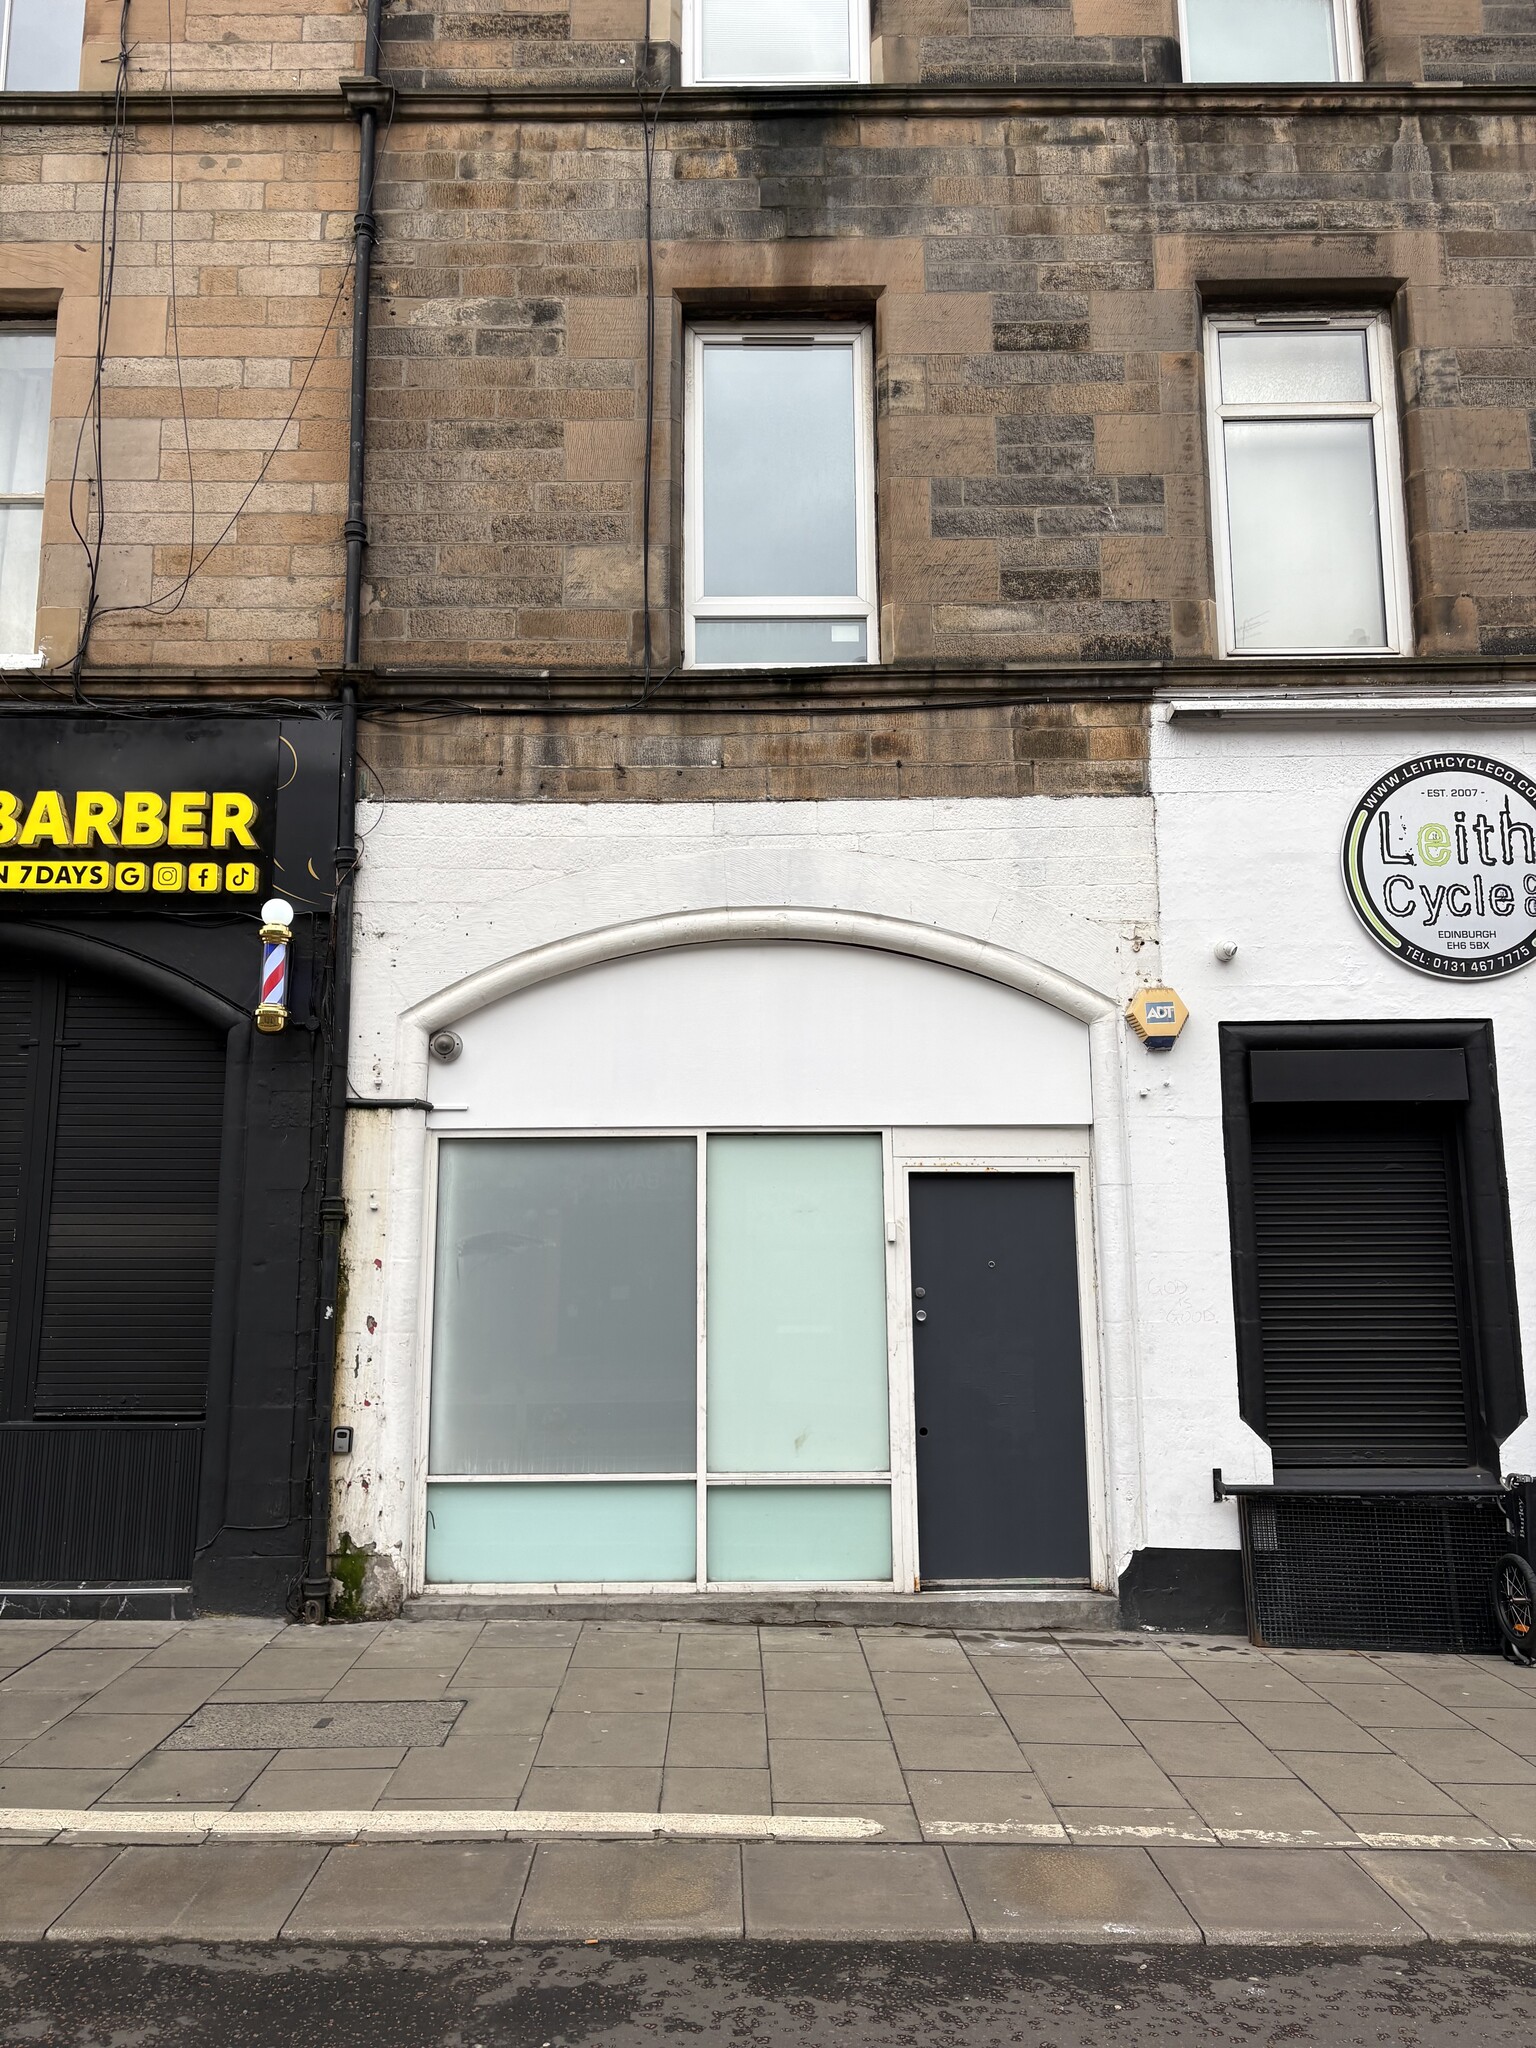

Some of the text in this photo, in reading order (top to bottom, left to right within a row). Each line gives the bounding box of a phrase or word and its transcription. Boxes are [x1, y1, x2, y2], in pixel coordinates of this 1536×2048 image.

[1363, 757, 1536, 809] WWW.LEITHCYCLECO.CO
[1427, 789, 1478, 797] EST. 2007
[1378, 794, 1536, 866] Leith
[1382, 874, 1515, 927] Cycle
[1438, 930, 1497, 939] EDINBURGH
[1446, 941, 1490, 950] EH6 5BX
[1405, 945, 1530, 973] TEL: 0131 467 7775
[1147, 1006, 1174, 1019] ADT
